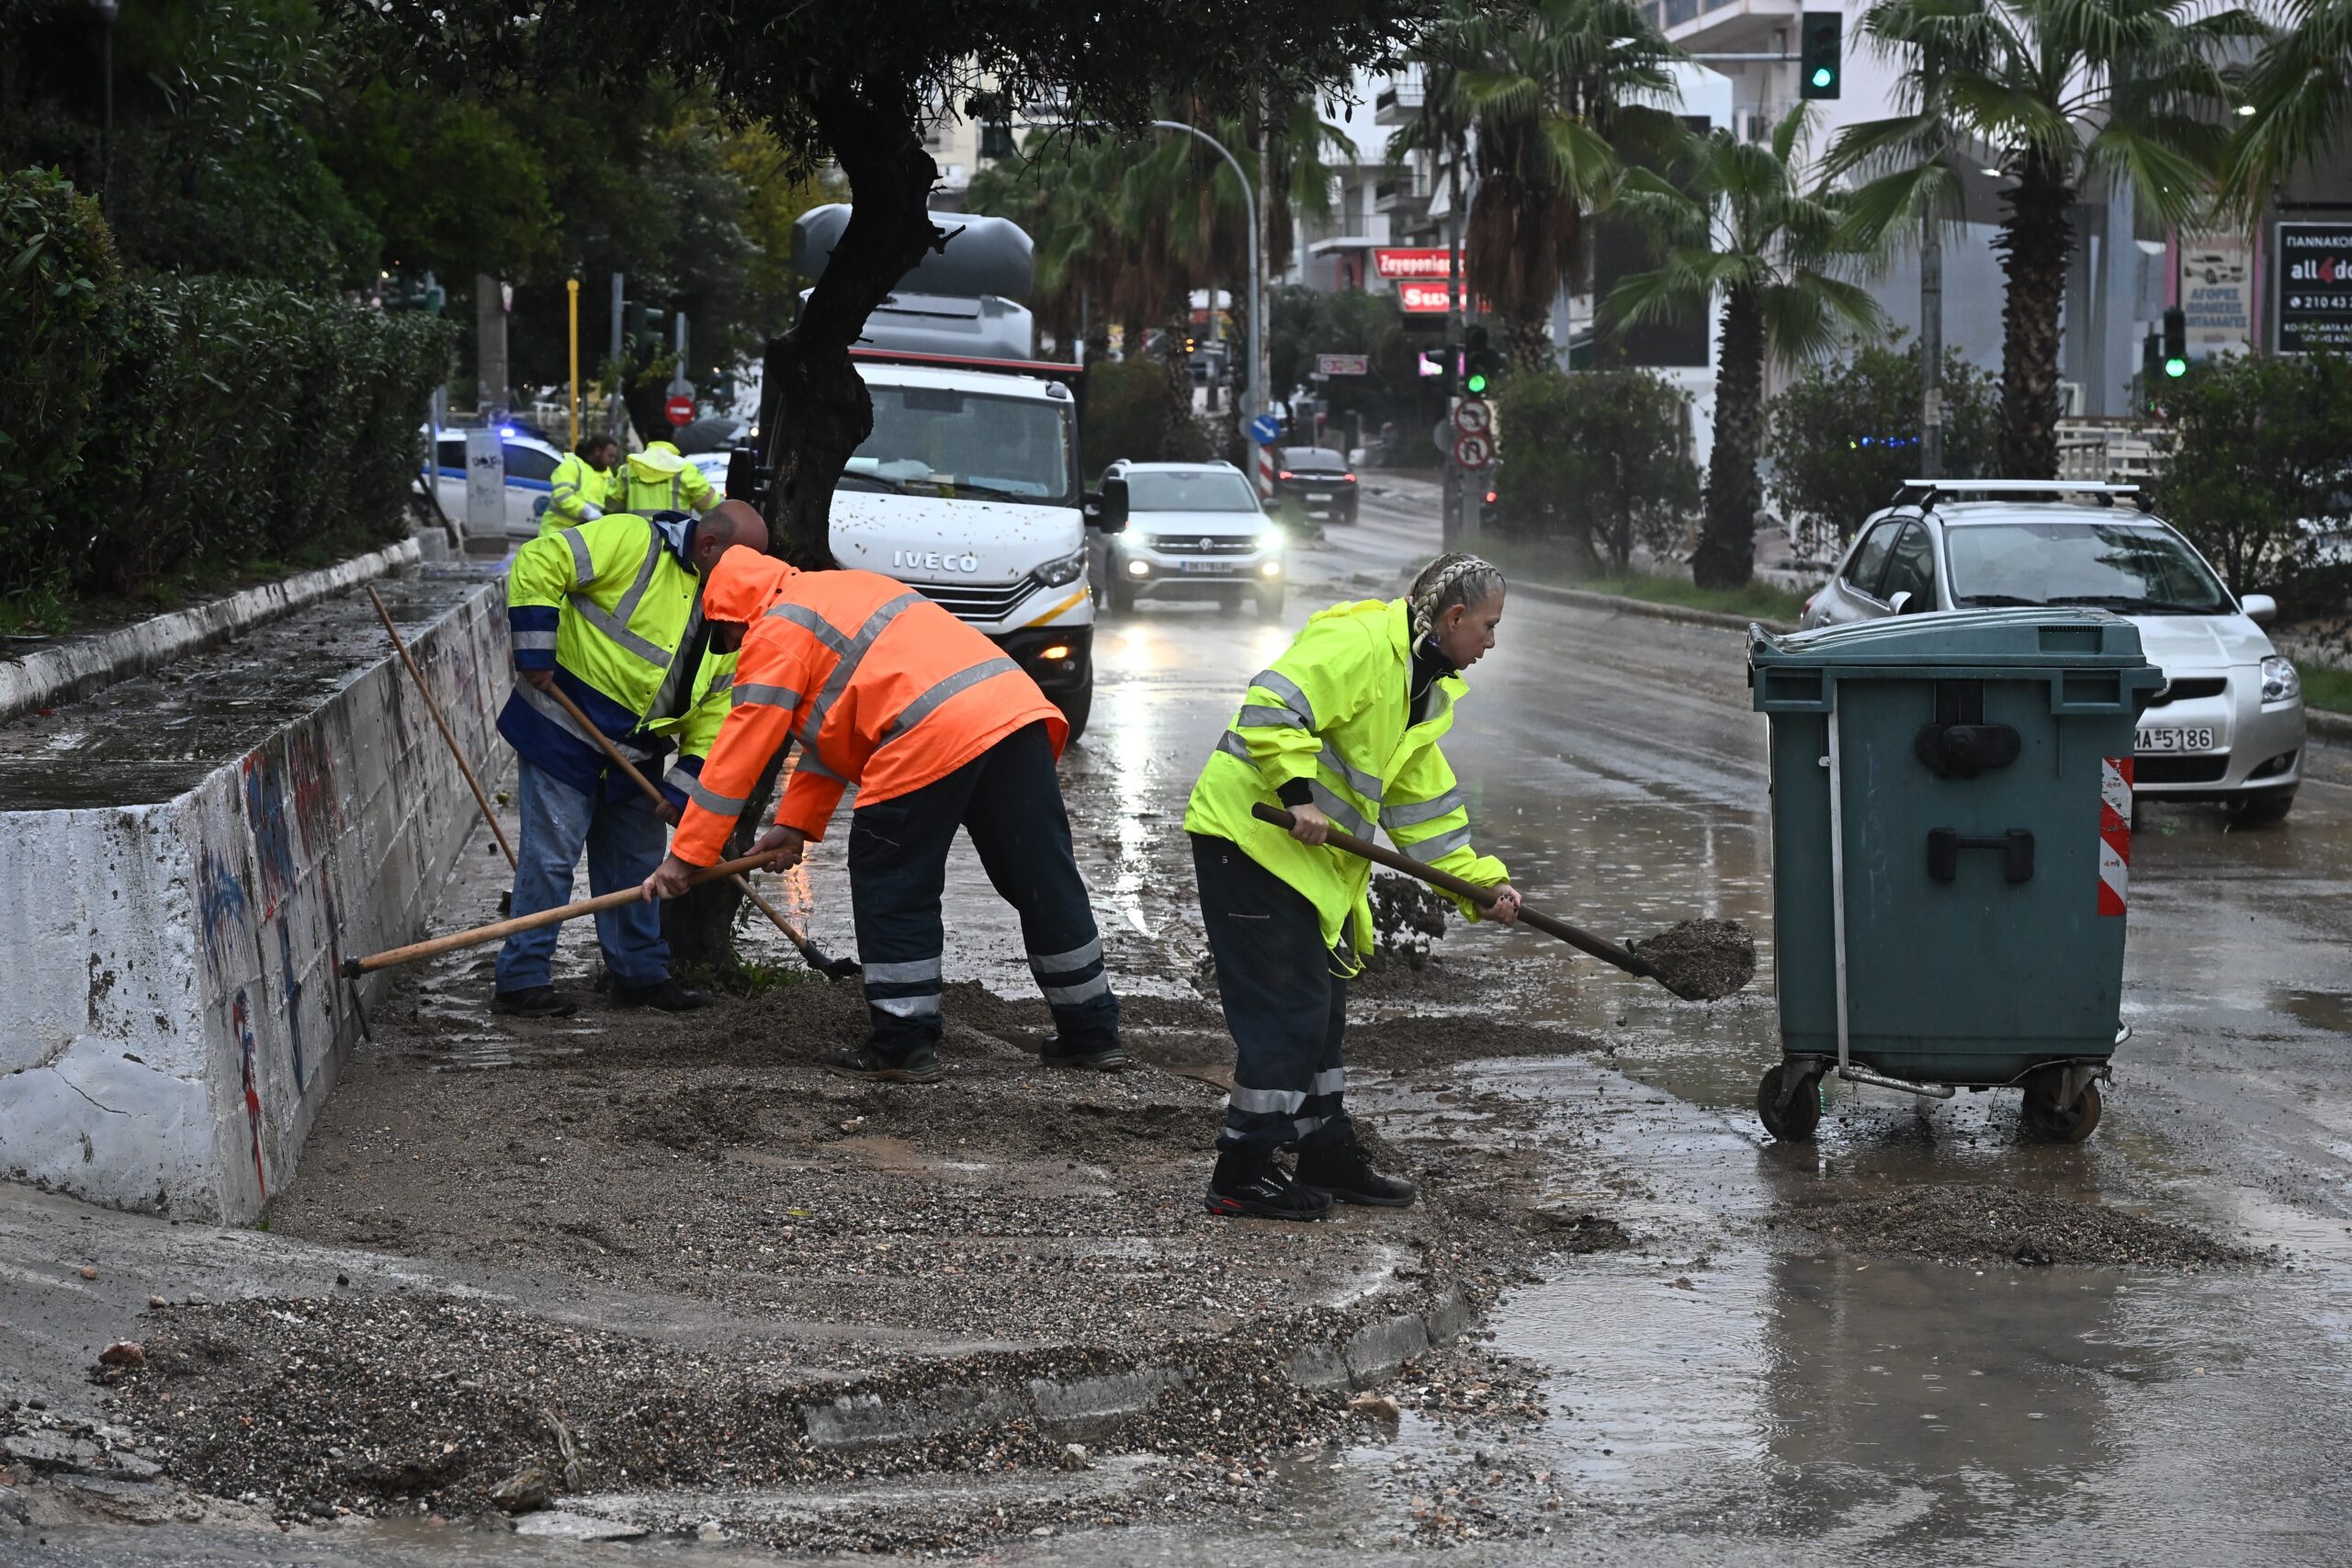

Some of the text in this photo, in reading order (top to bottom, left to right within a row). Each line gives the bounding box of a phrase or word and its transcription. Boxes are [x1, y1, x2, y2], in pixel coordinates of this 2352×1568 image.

[2286, 235, 2352, 248] ΓΙΑΝΝΑΚΟ
[2304, 296, 2329, 309] 210
[892, 550, 978, 573] IVECO
